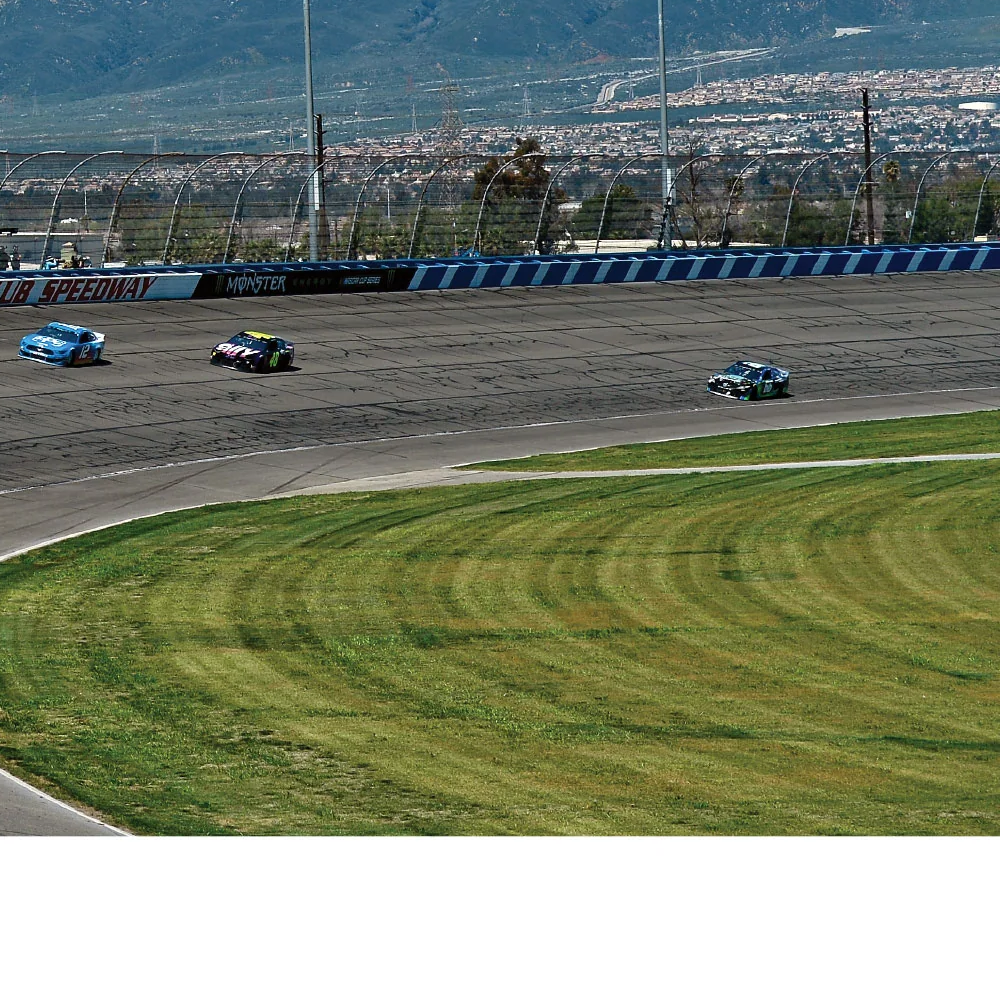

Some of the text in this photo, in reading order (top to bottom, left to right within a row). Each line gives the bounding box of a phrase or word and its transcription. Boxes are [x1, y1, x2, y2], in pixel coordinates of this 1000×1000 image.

[38, 276, 157, 303] SPEEDWAY
[226, 273, 286, 295] MONSTER
[79, 344, 90, 359] 12
[269, 351, 280, 368] 48
